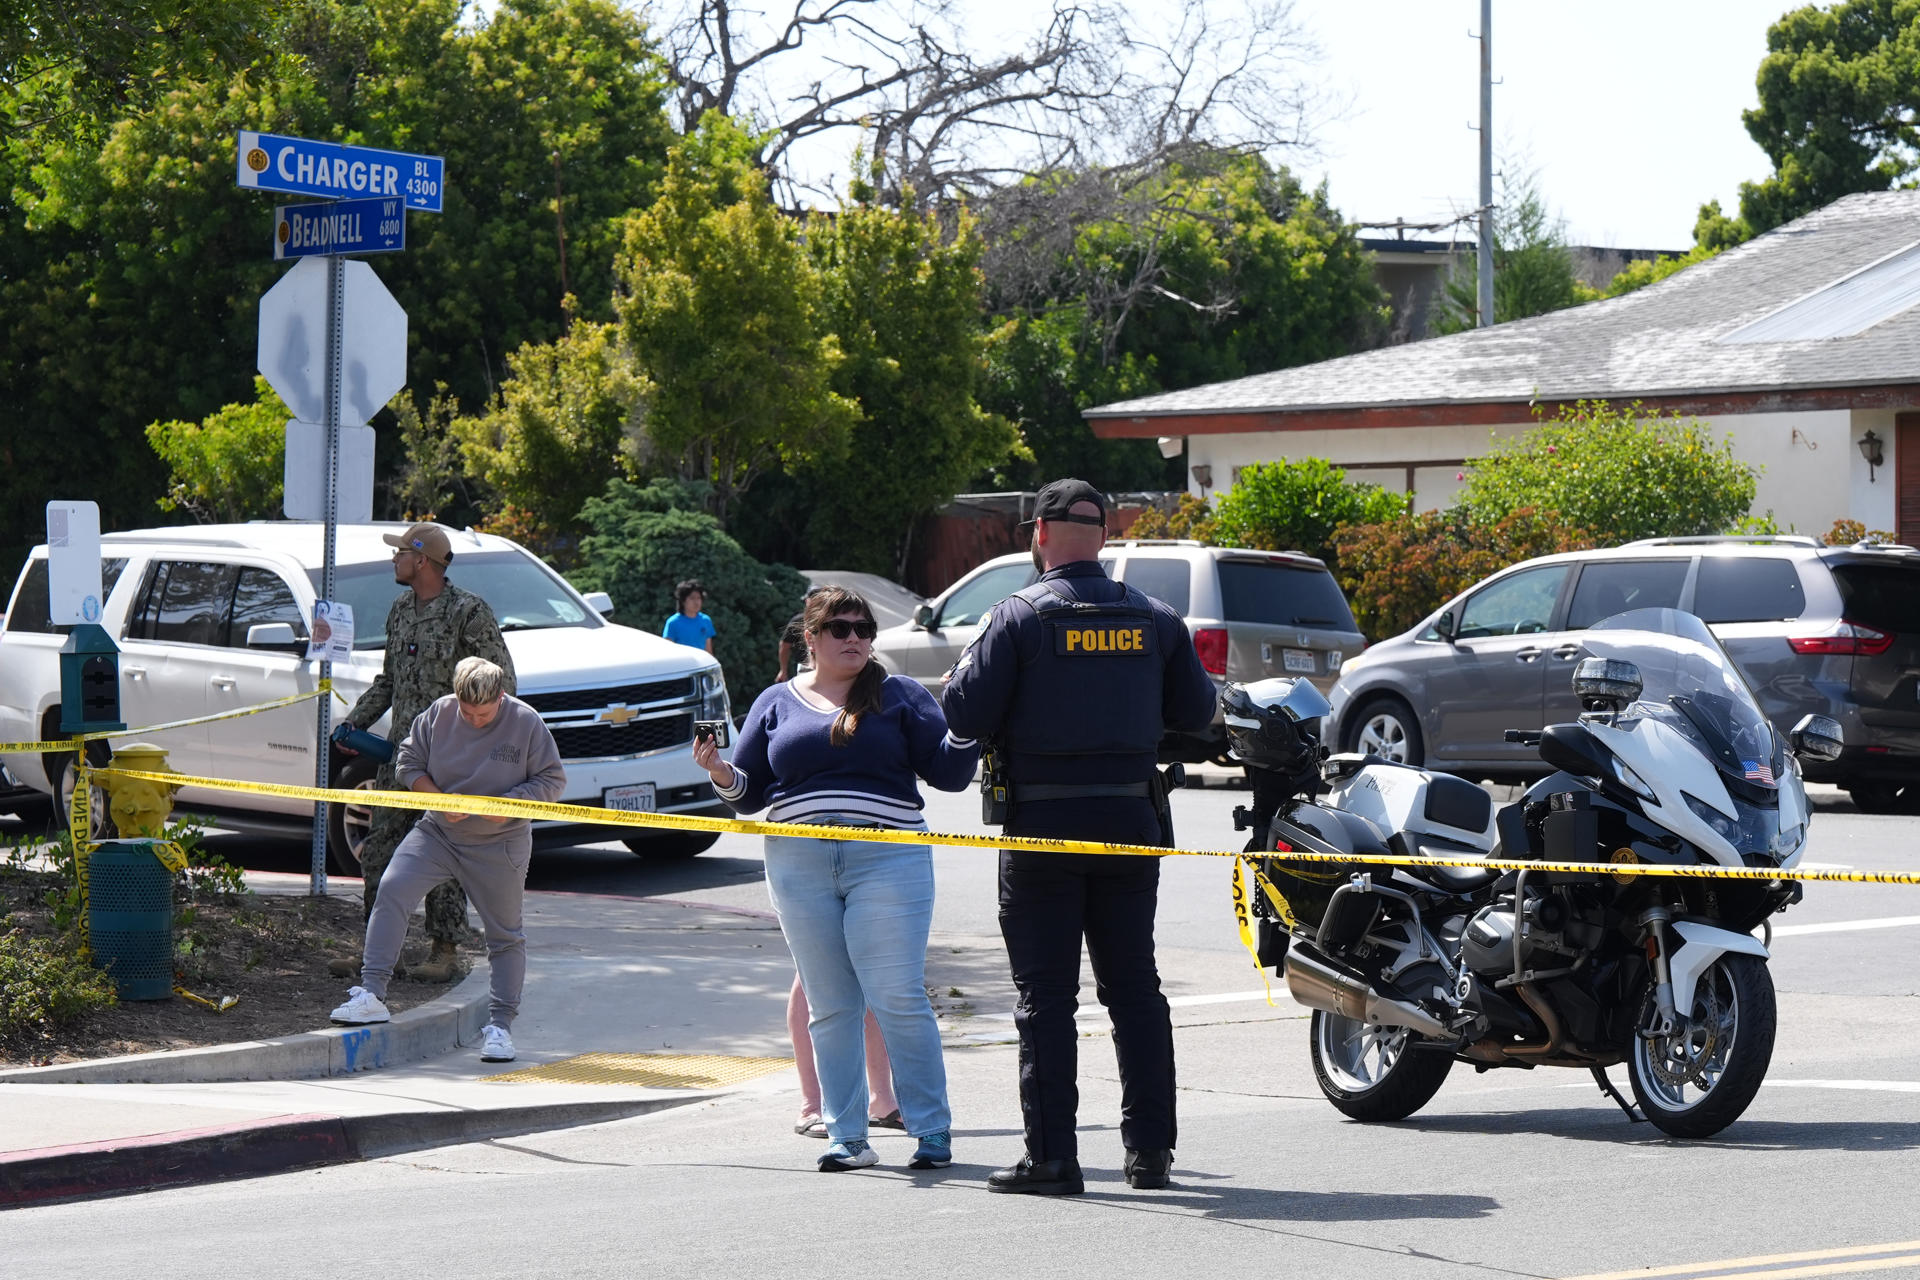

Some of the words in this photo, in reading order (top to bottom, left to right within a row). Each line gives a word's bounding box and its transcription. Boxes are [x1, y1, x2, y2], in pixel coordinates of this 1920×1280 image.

[277, 145, 399, 196] CHARGER
[414, 160, 430, 178] BL
[405, 178, 438, 197] 4300
[383, 201, 397, 217] WY
[292, 213, 363, 249] BEADNELL
[379, 219, 400, 236] 6800
[1066, 628, 1144, 652] POLICE
